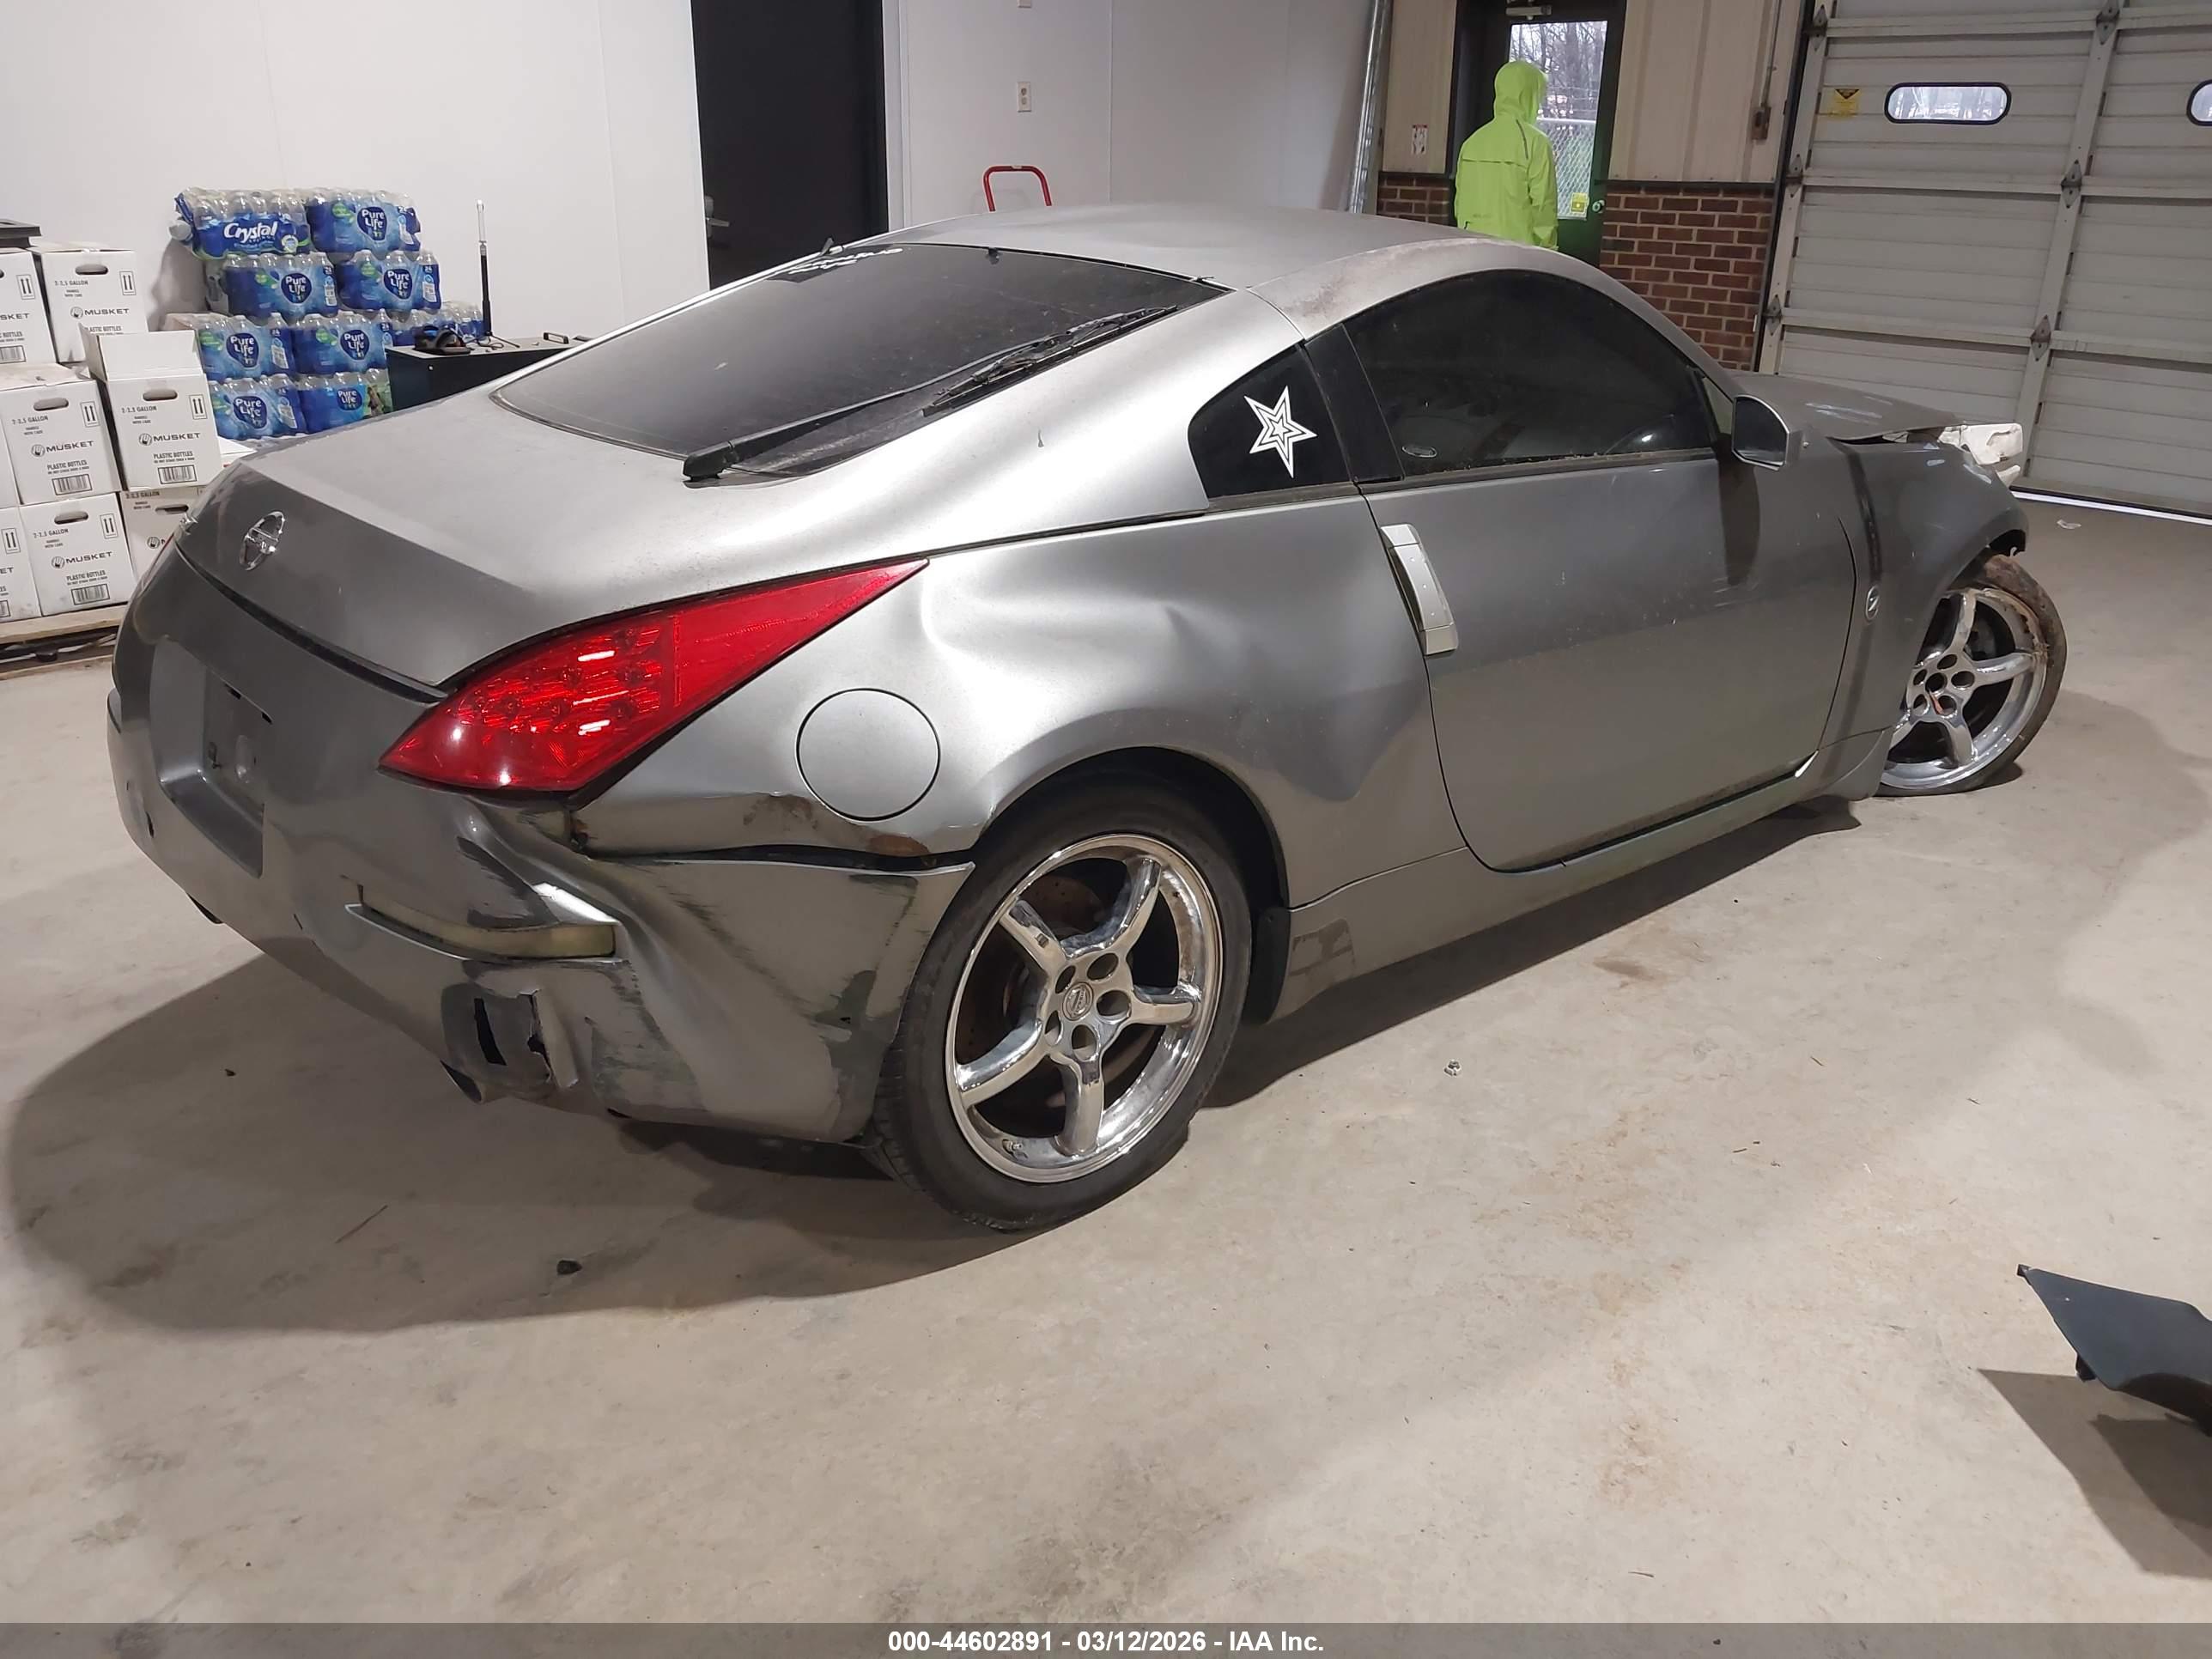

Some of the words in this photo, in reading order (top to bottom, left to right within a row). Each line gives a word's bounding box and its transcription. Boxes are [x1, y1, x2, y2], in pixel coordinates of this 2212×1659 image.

[362, 209, 386, 219] Pure
[365, 217, 384, 230] Life
[223, 221, 278, 244] Crystal
[285, 276, 307, 285] Pure
[387, 270, 410, 281] Pure
[390, 277, 408, 289] Life
[289, 283, 306, 295] Life
[0, 313, 30, 321] SKET
[230, 336, 255, 345] Pure
[344, 333, 365, 342] Pure
[234, 343, 254, 356] Life
[348, 340, 365, 352] Life
[235, 398, 262, 408] Pure
[341, 395, 358, 405] Life
[240, 405, 261, 418] Life
[27, 415, 49, 423] GALLON
[153, 432, 201, 442] MUSKET
[46, 440, 94, 453] MUSKET
[46, 462, 67, 471] PLASTIC
[67, 459, 88, 468] BOTTLES
[48, 528, 70, 537] GALLON
[65, 550, 113, 564] MUSKET
[66, 573, 86, 581] PLASTIC
[86, 569, 106, 579] BOTTLES
